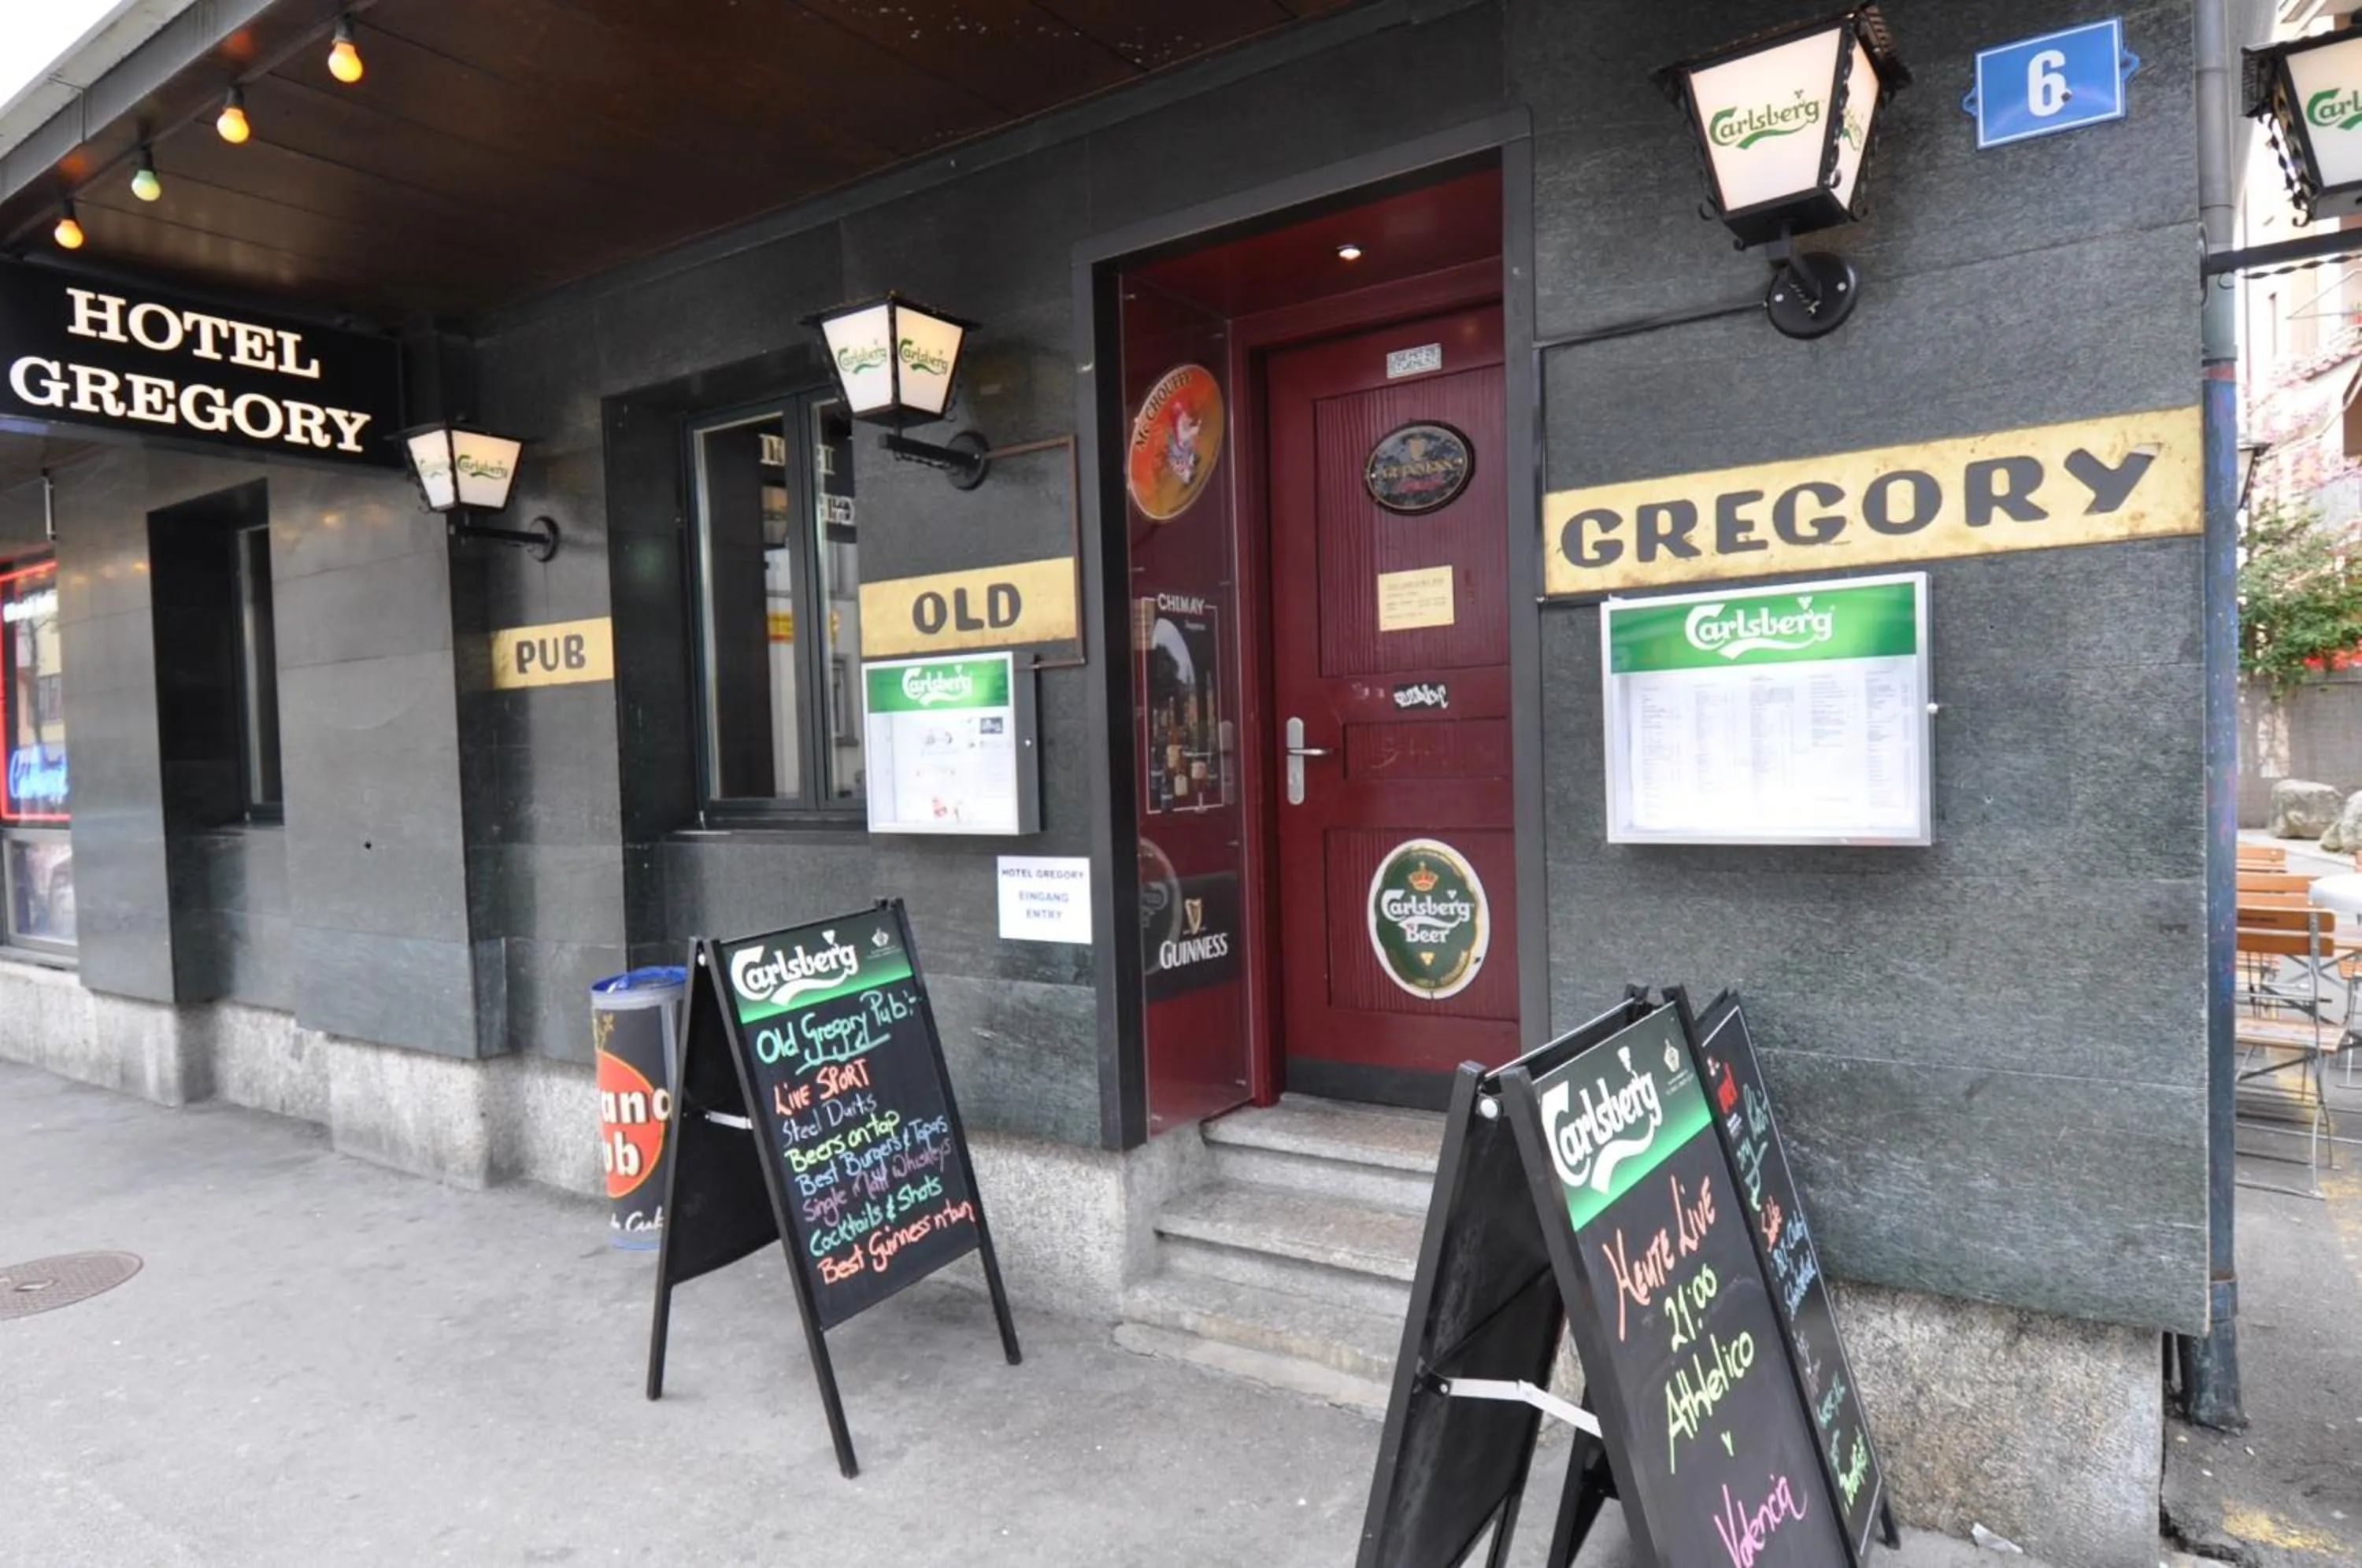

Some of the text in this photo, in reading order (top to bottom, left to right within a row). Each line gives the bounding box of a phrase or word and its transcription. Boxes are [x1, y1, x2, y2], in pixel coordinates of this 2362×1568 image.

[2027, 50, 2071, 116] 6
[1709, 99, 1820, 146] Carlsberg
[67, 288, 319, 378] HOTEL
[899, 338, 948, 374] Carlsberg
[9, 357, 370, 452] GREGORY
[457, 454, 509, 479] Carlsberg
[1560, 443, 2162, 568] GREGORY
[913, 582, 1021, 634] OLD
[1157, 593, 1205, 615] CHIMAY
[1685, 604, 1834, 652] Carlsberg
[516, 634, 585, 674] PUB
[902, 668, 972, 700] Carlsberg
[1002, 869, 1033, 878] HOTEL
[1019, 891, 1069, 903] EINGANG
[1026, 909, 1063, 919] ENTRY
[1381, 889, 1471, 921] Carlsberg
[1160, 933, 1228, 969] GUINNESS
[1405, 926, 1450, 943] Beer
[731, 945, 858, 1000] Carlsberg
[757, 1022, 799, 1063] Old
[784, 1111, 901, 1172] Beers on tap
[1542, 1072, 1662, 1187] Carlsberg
[795, 1159, 839, 1196] Best
[802, 1187, 847, 1226] Single
[809, 1202, 883, 1257] Cocktails
[898, 1175, 942, 1211] Shots
[817, 1244, 864, 1285] Best
[1664, 1263, 1717, 1352] 21:00
[1714, 1474, 1807, 1568] Valencia
